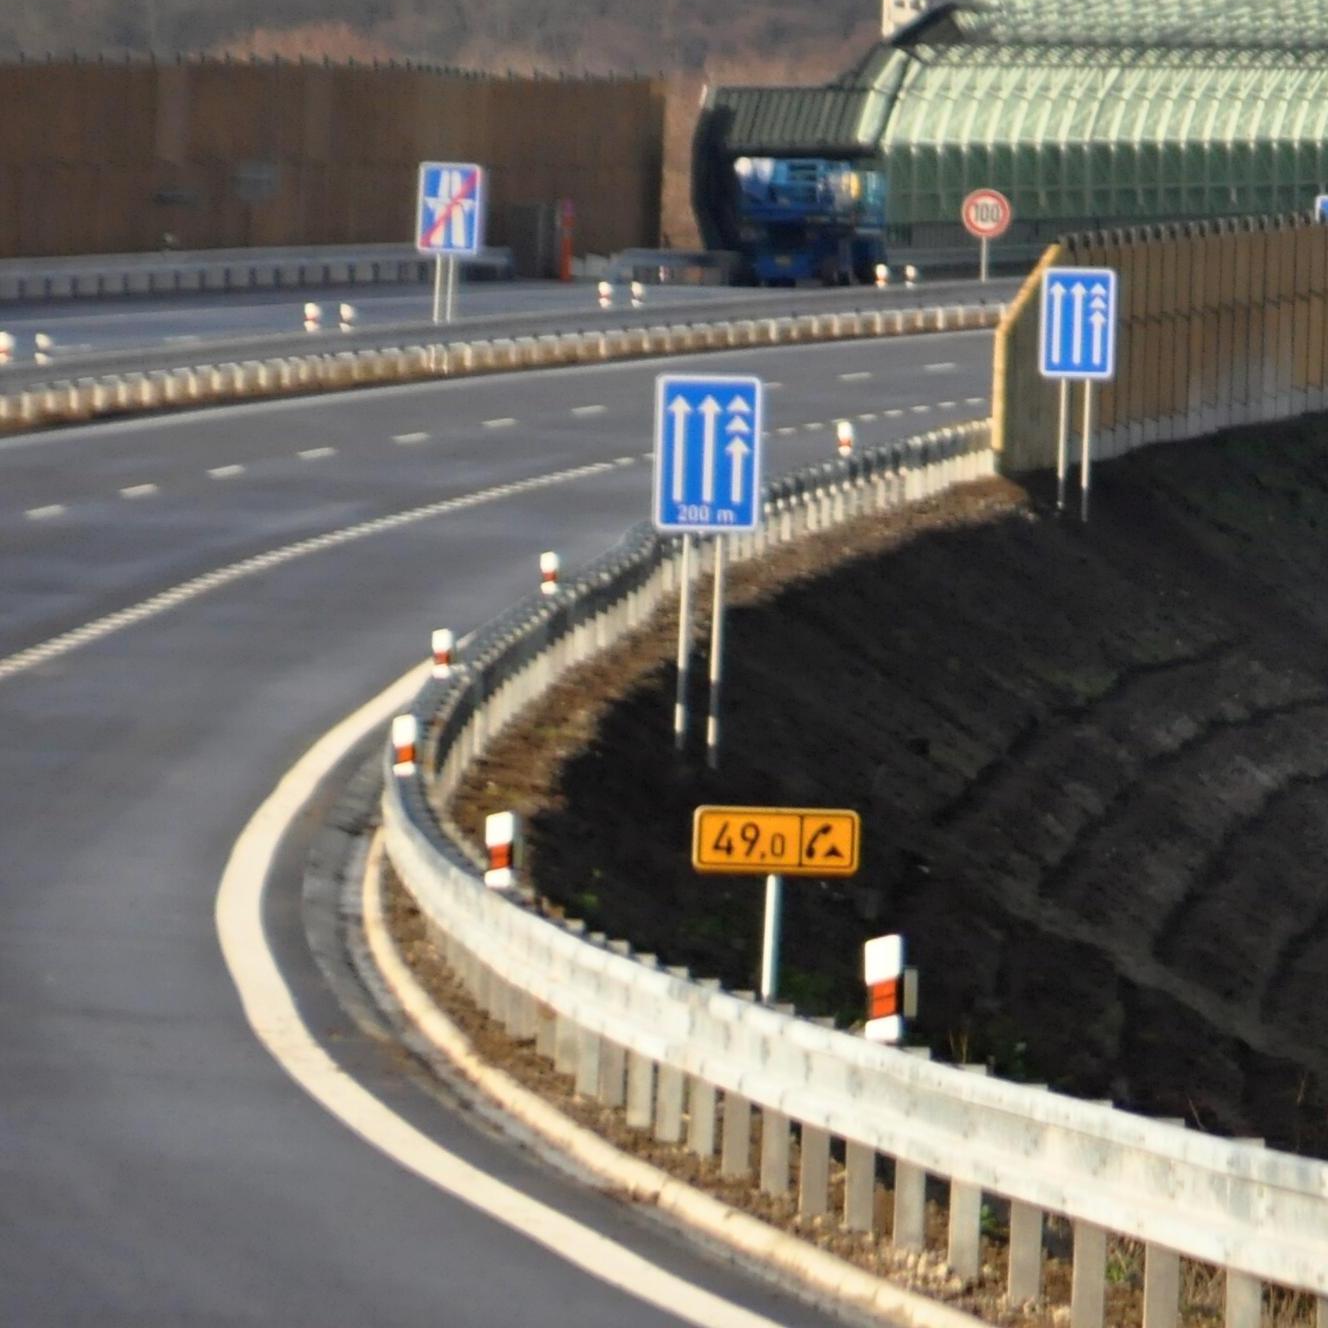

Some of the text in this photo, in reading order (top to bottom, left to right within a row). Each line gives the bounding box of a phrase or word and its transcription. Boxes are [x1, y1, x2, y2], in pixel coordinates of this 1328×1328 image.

[974, 202, 1000, 223] 100
[677, 503, 735, 523] 200 m
